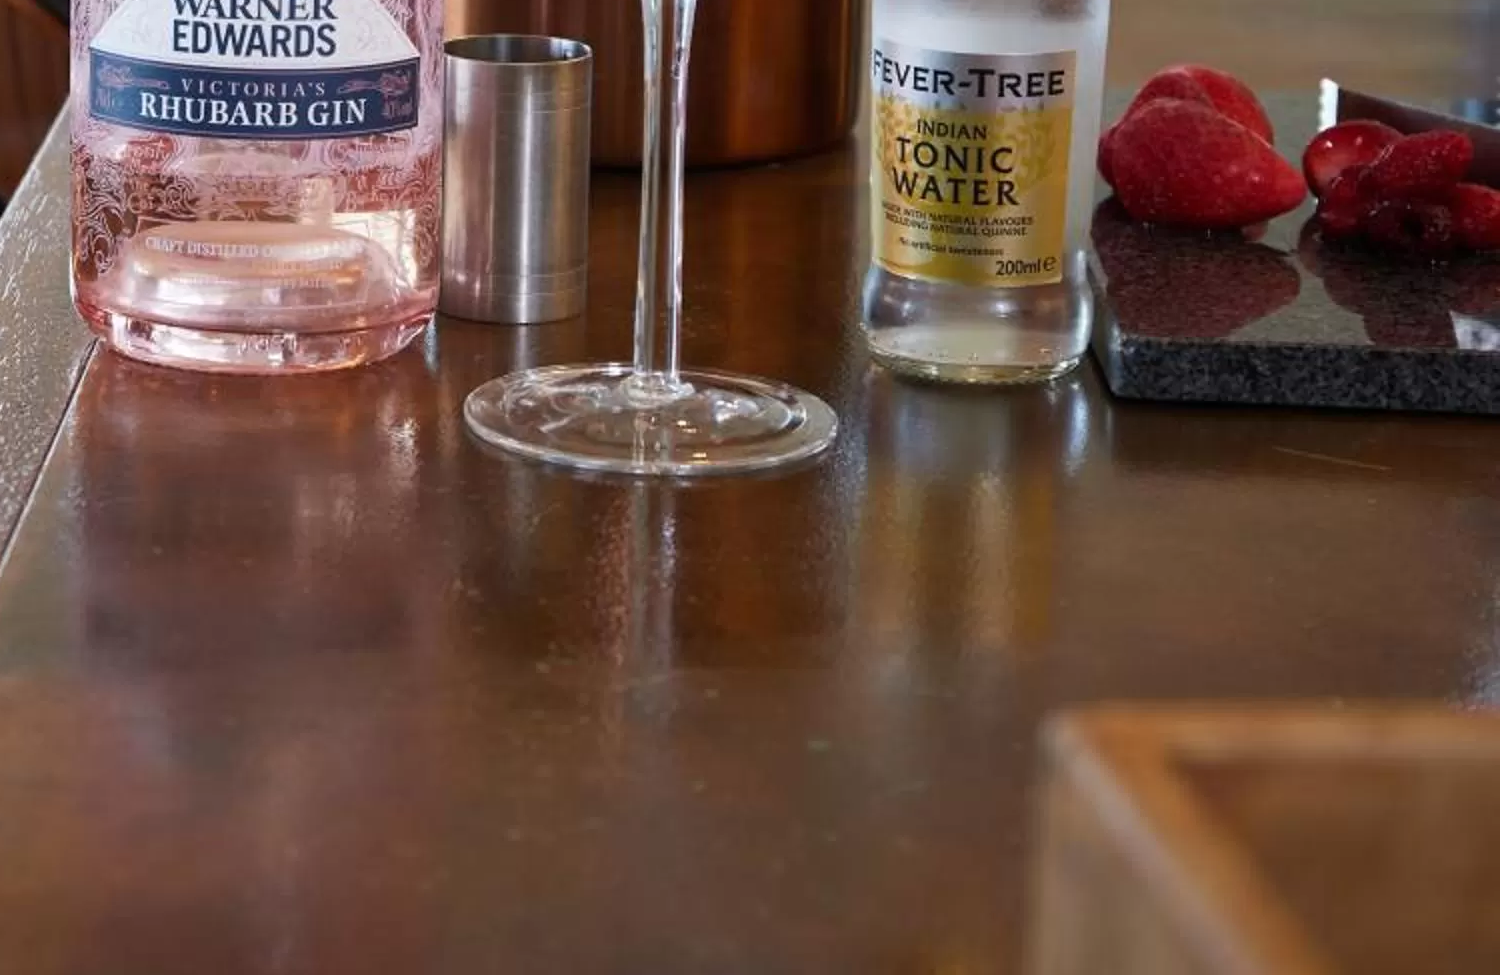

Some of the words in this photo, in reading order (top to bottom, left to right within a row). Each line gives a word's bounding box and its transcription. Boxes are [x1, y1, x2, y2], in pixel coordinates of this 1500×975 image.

[173, 19, 337, 57] EDWARDS
[182, 78, 325, 97] VICTORIA'S
[139, 92, 298, 126] RHUBARB
[307, 98, 367, 126] GIN
[916, 119, 988, 140] INDIAN
[896, 137, 1013, 174] TONIC
[892, 166, 1021, 206] WATER
[903, 208, 927, 219] WITH
[929, 212, 977, 226] NATURAL
[930, 222, 981, 236] NATURAL
[995, 258, 1041, 276] 200ml
